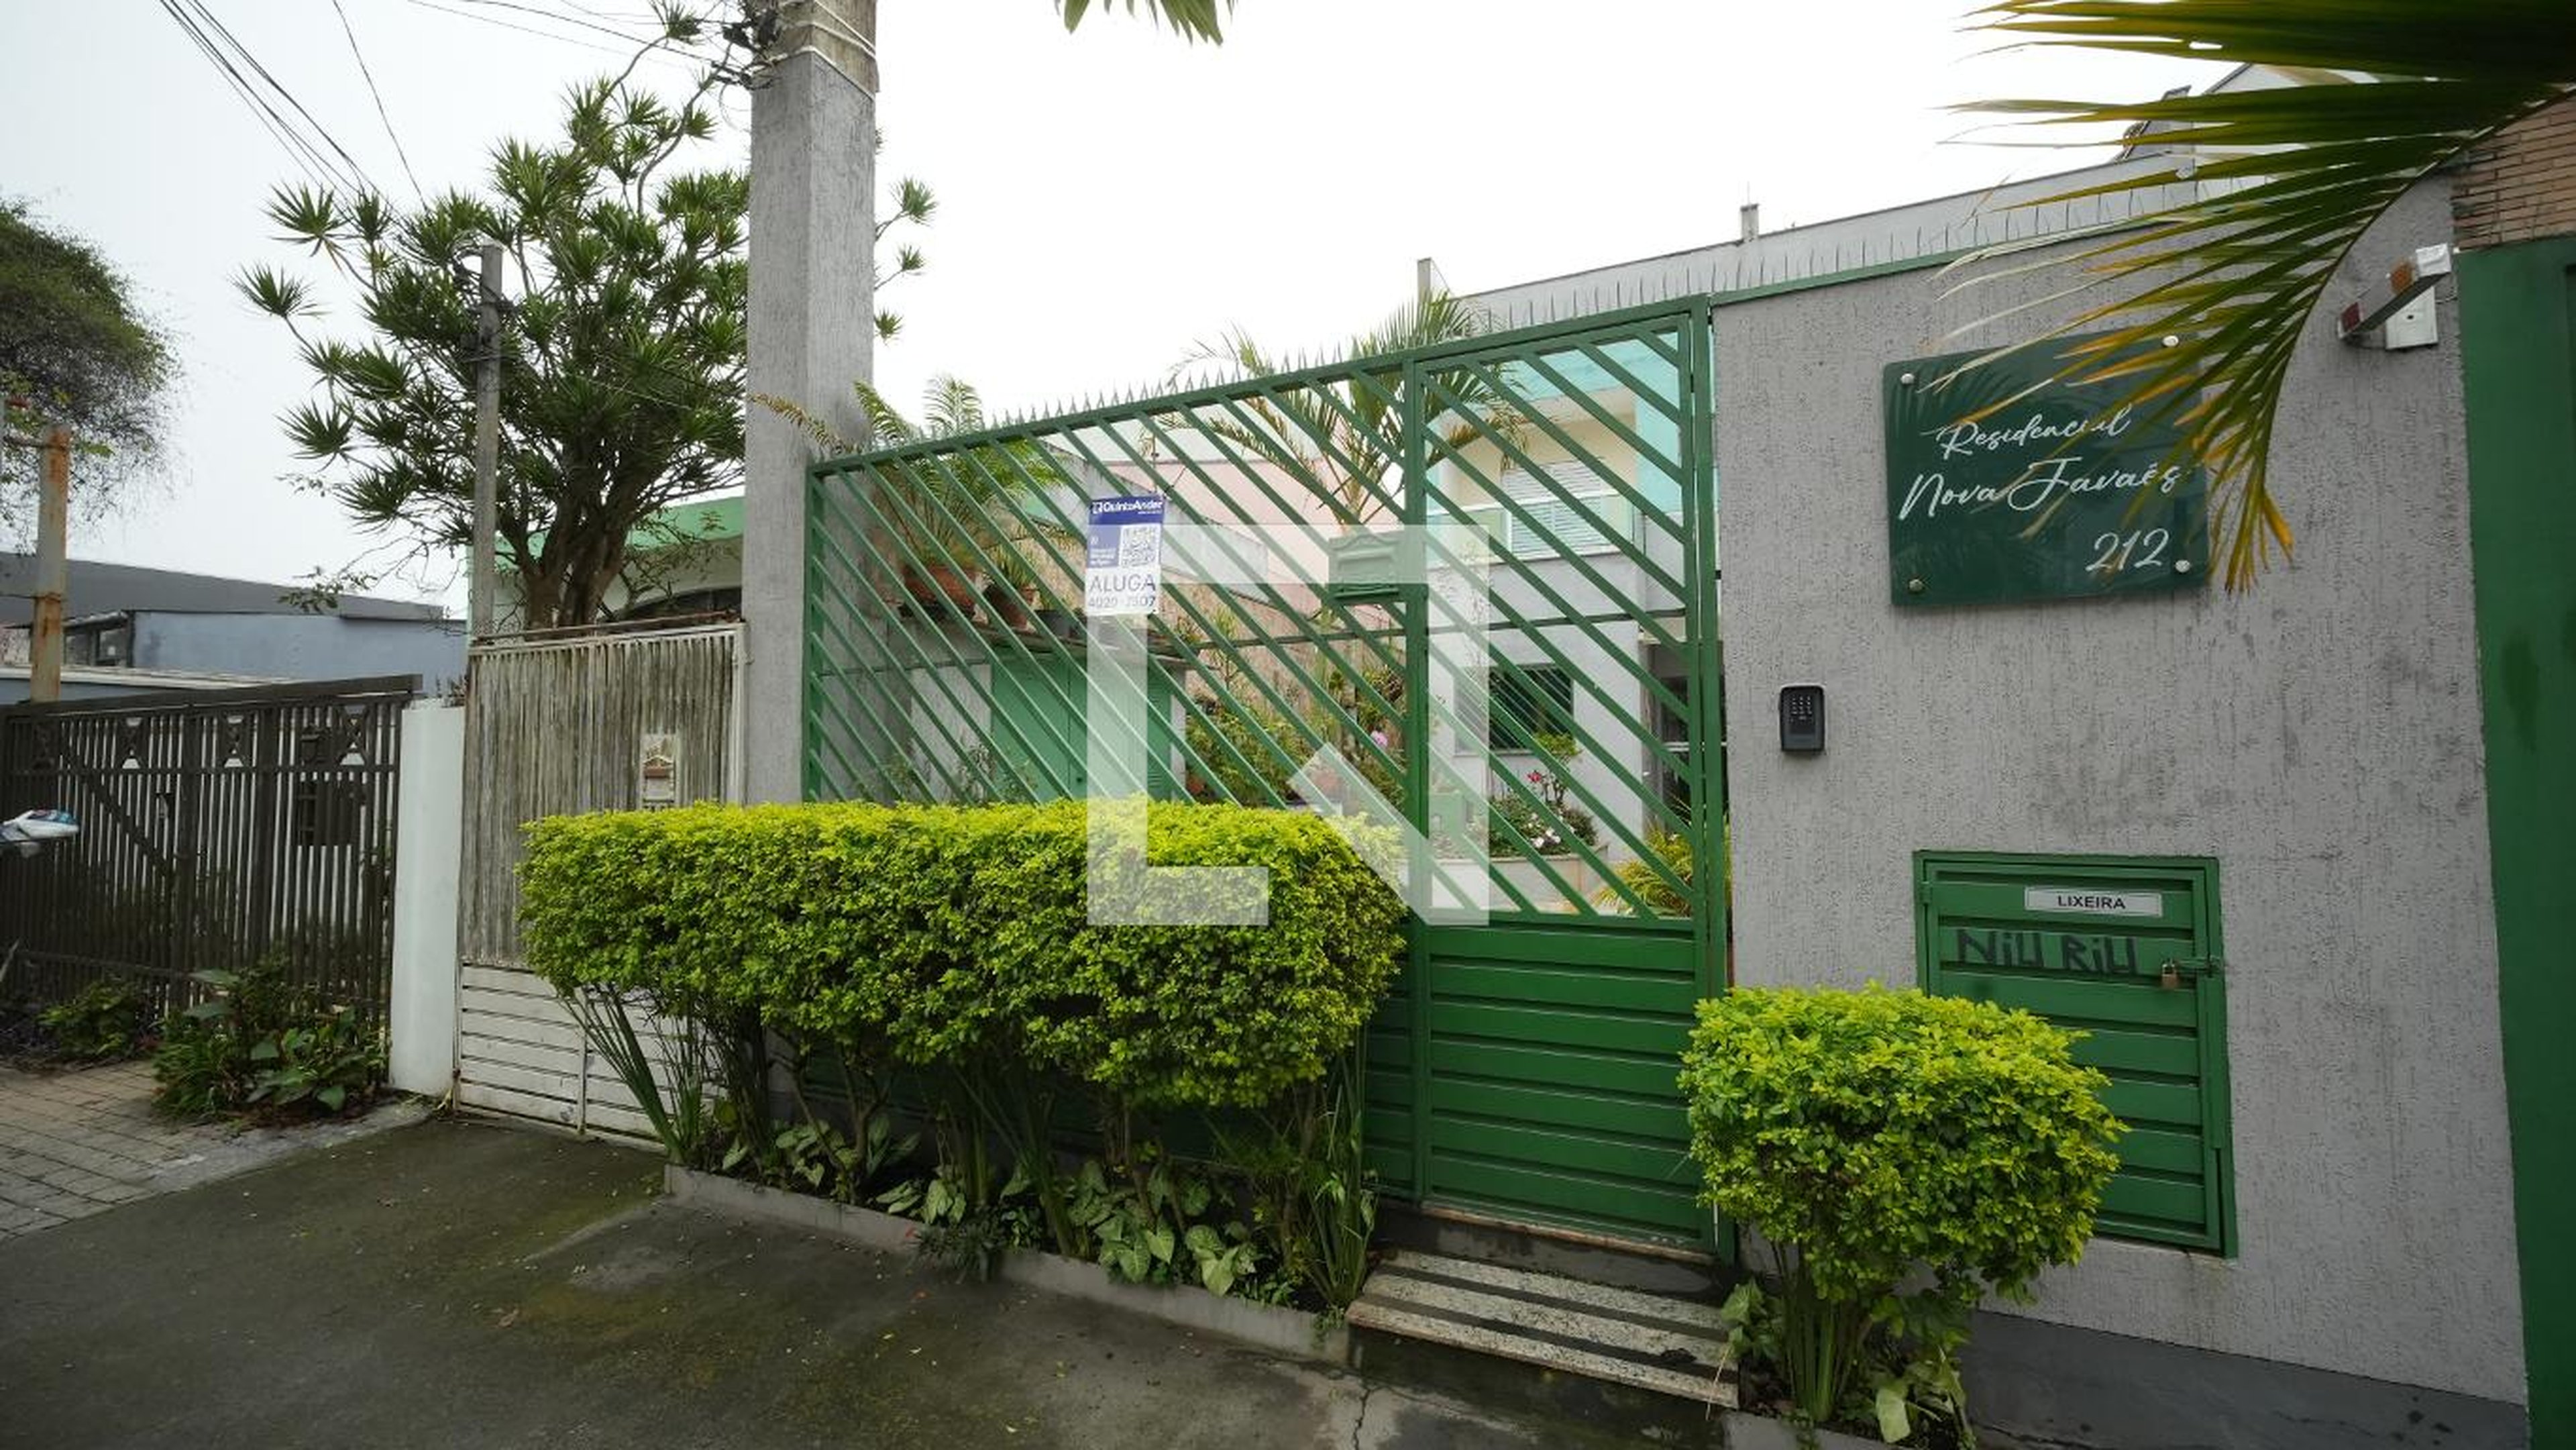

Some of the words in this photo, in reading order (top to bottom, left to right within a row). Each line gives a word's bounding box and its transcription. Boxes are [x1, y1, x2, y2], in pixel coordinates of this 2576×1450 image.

[1899, 473, 2000, 520] Nova
[2086, 529, 2169, 572] 212
[1089, 574, 1155, 592] ALUGA
[2057, 895, 2126, 909] LIXEIRA
